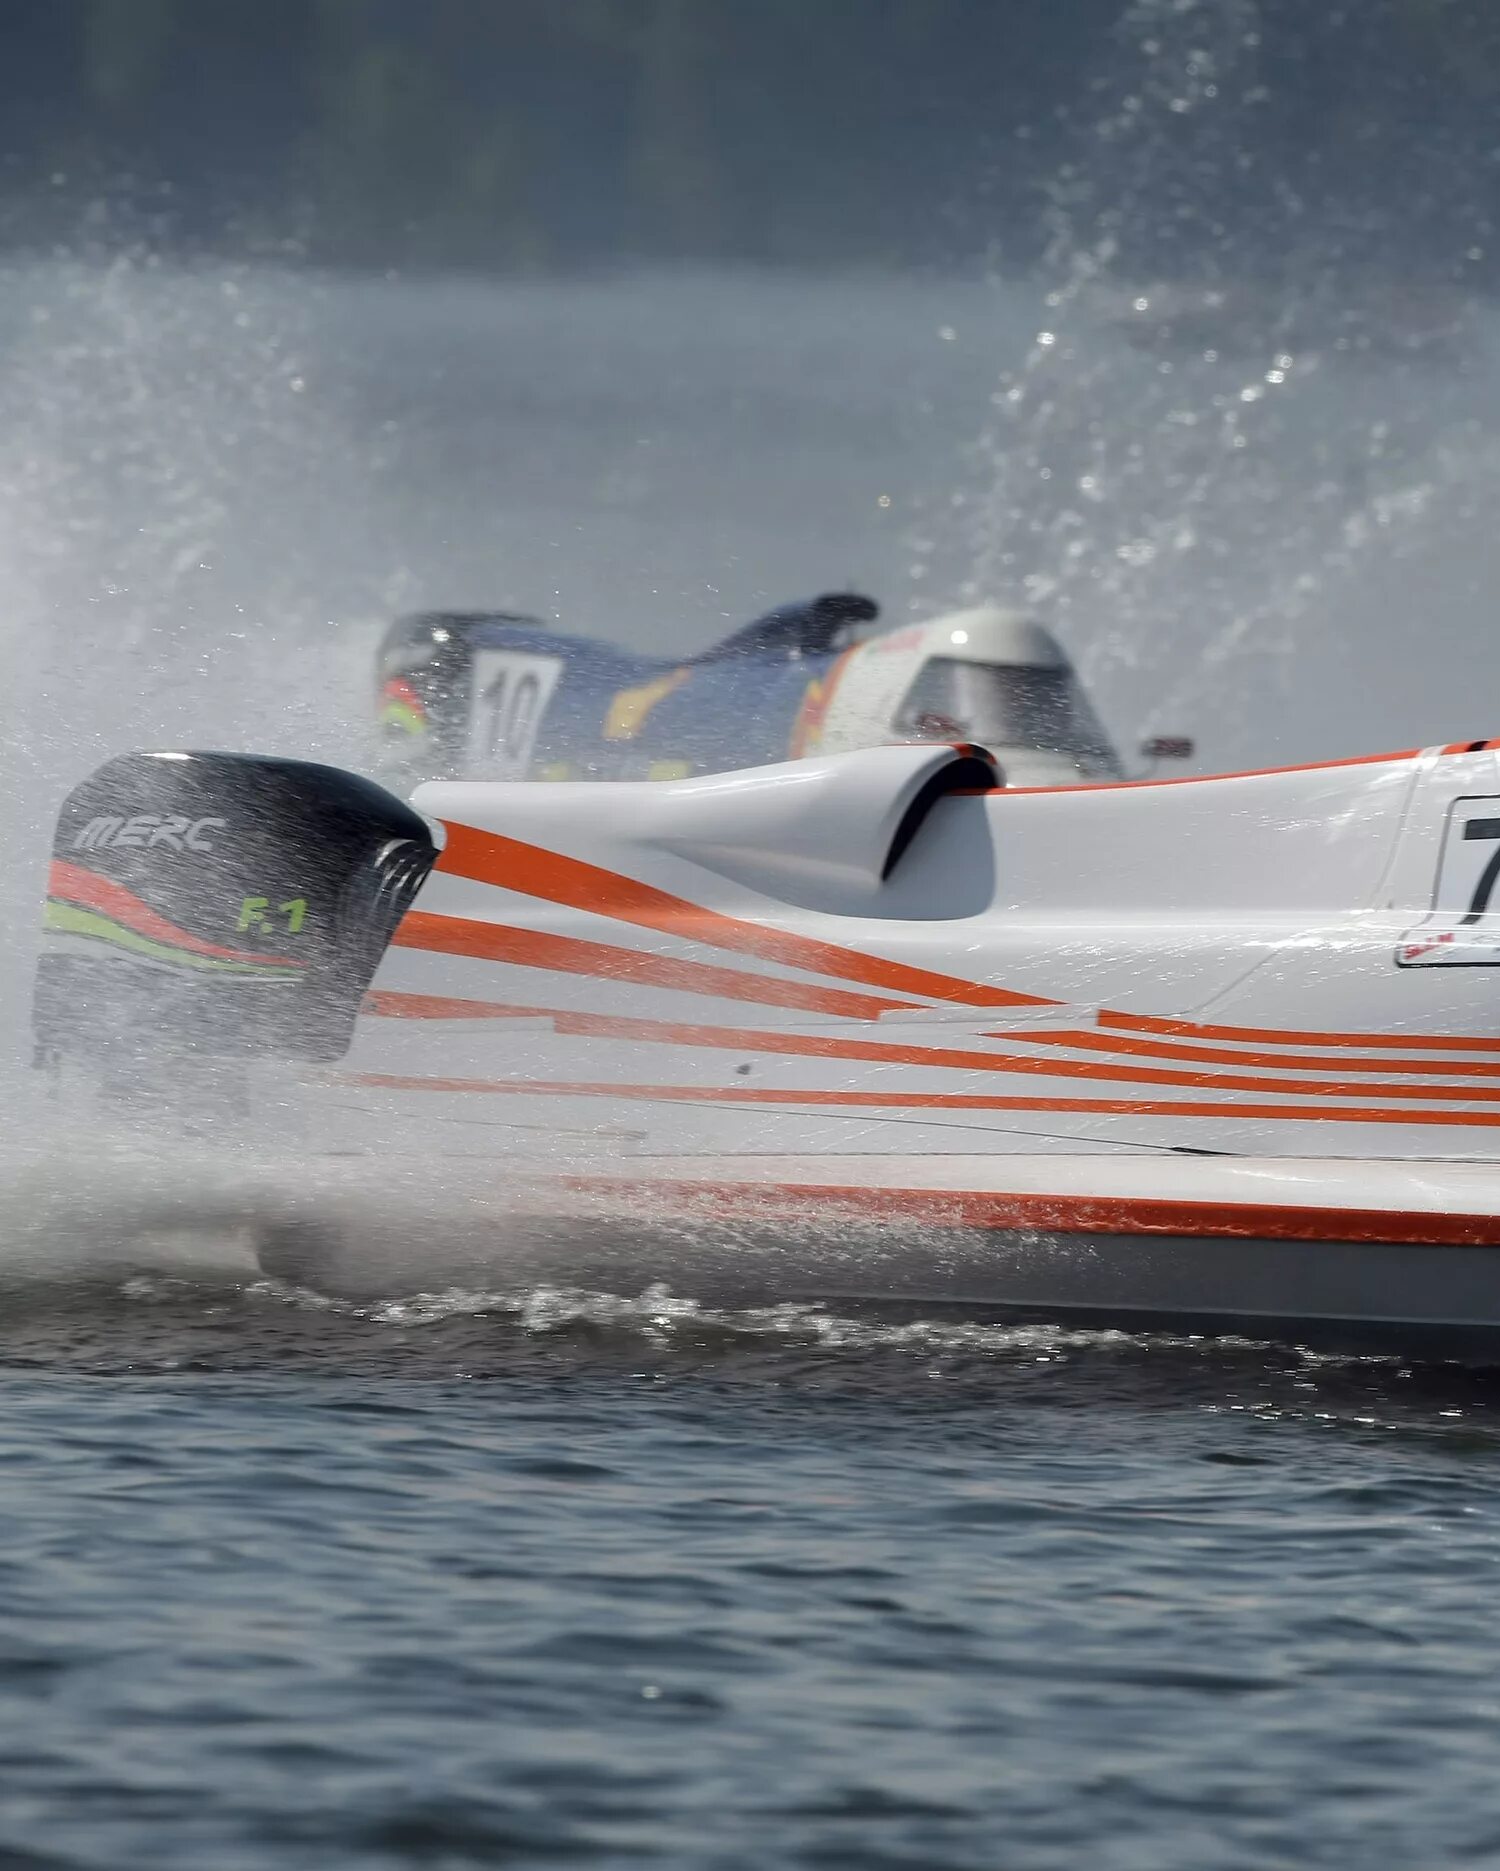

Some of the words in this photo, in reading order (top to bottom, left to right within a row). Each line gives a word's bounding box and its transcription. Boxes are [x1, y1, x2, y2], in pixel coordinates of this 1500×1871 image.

[484, 667, 541, 760] 10
[72, 815, 226, 851] MERC
[236, 897, 308, 934] F.1
